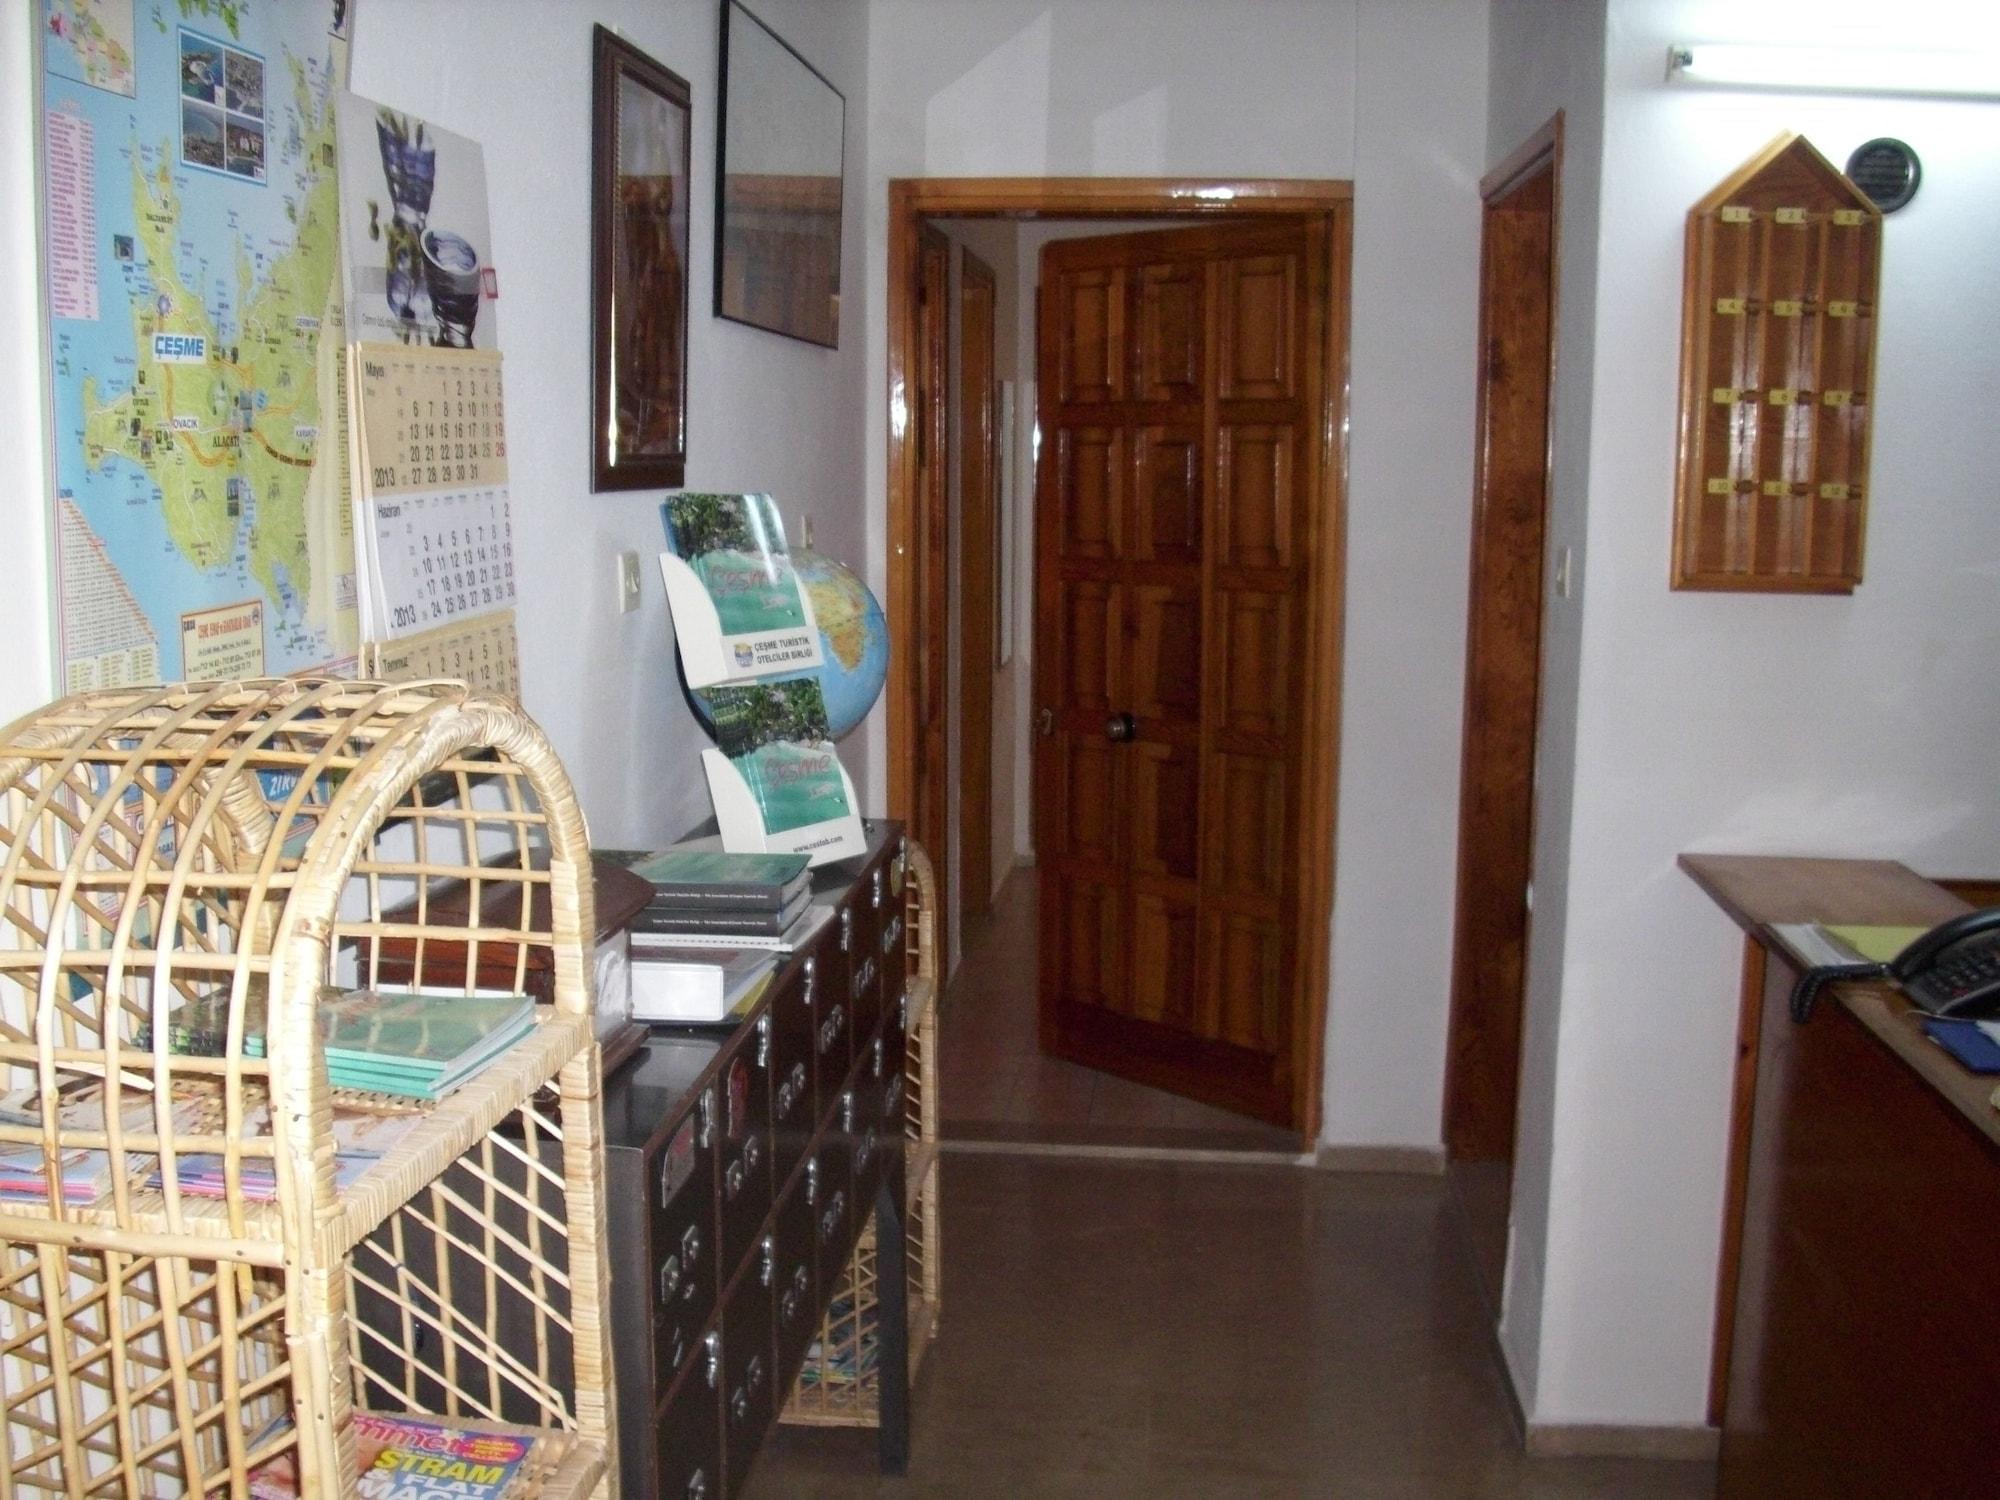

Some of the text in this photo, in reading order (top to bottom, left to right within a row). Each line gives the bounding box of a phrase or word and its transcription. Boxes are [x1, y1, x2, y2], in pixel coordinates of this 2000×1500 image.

[456, 380, 462, 396] 2
[470, 380, 475, 397] 3
[413, 400, 419, 418] 6
[428, 400, 433, 417] 7
[443, 400, 449, 418] 8
[457, 400, 463, 417] 9
[468, 400, 477, 417] 10
[410, 423, 420, 440] 13
[425, 423, 434, 439] 14
[440, 422, 449, 439] 15
[454, 422, 463, 438] 16
[468, 422, 477, 438] 17
[410, 445, 420, 462] 20
[425, 445, 434, 461] 21
[440, 444, 450, 460] 22
[455, 443, 464, 459] 23
[468, 443, 477, 458] 24
[374, 464, 479, 488] 2013 27 28 29 30 31
[504, 502, 510, 518] 2
[423, 535, 429, 552] 3
[438, 532, 443, 548] 4
[451, 530, 457, 547] 5
[465, 528, 471, 545] 6
[478, 526, 483, 542] 7
[505, 521, 511, 537] 9
[422, 557, 432, 574] 10
[437, 555, 446, 571] 11
[450, 552, 459, 568] 12
[464, 549, 473, 565] 13
[478, 546, 486, 562] 14
[503, 542, 511, 558] 16
[427, 578, 436, 596] 17
[441, 575, 451, 592] 18
[454, 572, 463, 589] 19
[466, 569, 476, 587] 20
[480, 567, 488, 583] 21
[504, 561, 513, 577] 23
[394, 603, 416, 629] 2013
[431, 601, 442, 618] 24
[445, 597, 455, 614] 25
[457, 593, 467, 611] 26
[469, 590, 478, 608] 27
[482, 587, 492, 604] 28
[440, 655, 446, 673] 2
[455, 651, 461, 668] 3
[468, 649, 474, 663] 4
[482, 643, 488, 660] 5
[480, 663, 490, 681] 12
[374, 1449, 506, 1486] STRAM
[355, 1478, 486, 1500] MAG
[402, 1473, 494, 1497] FLAT
